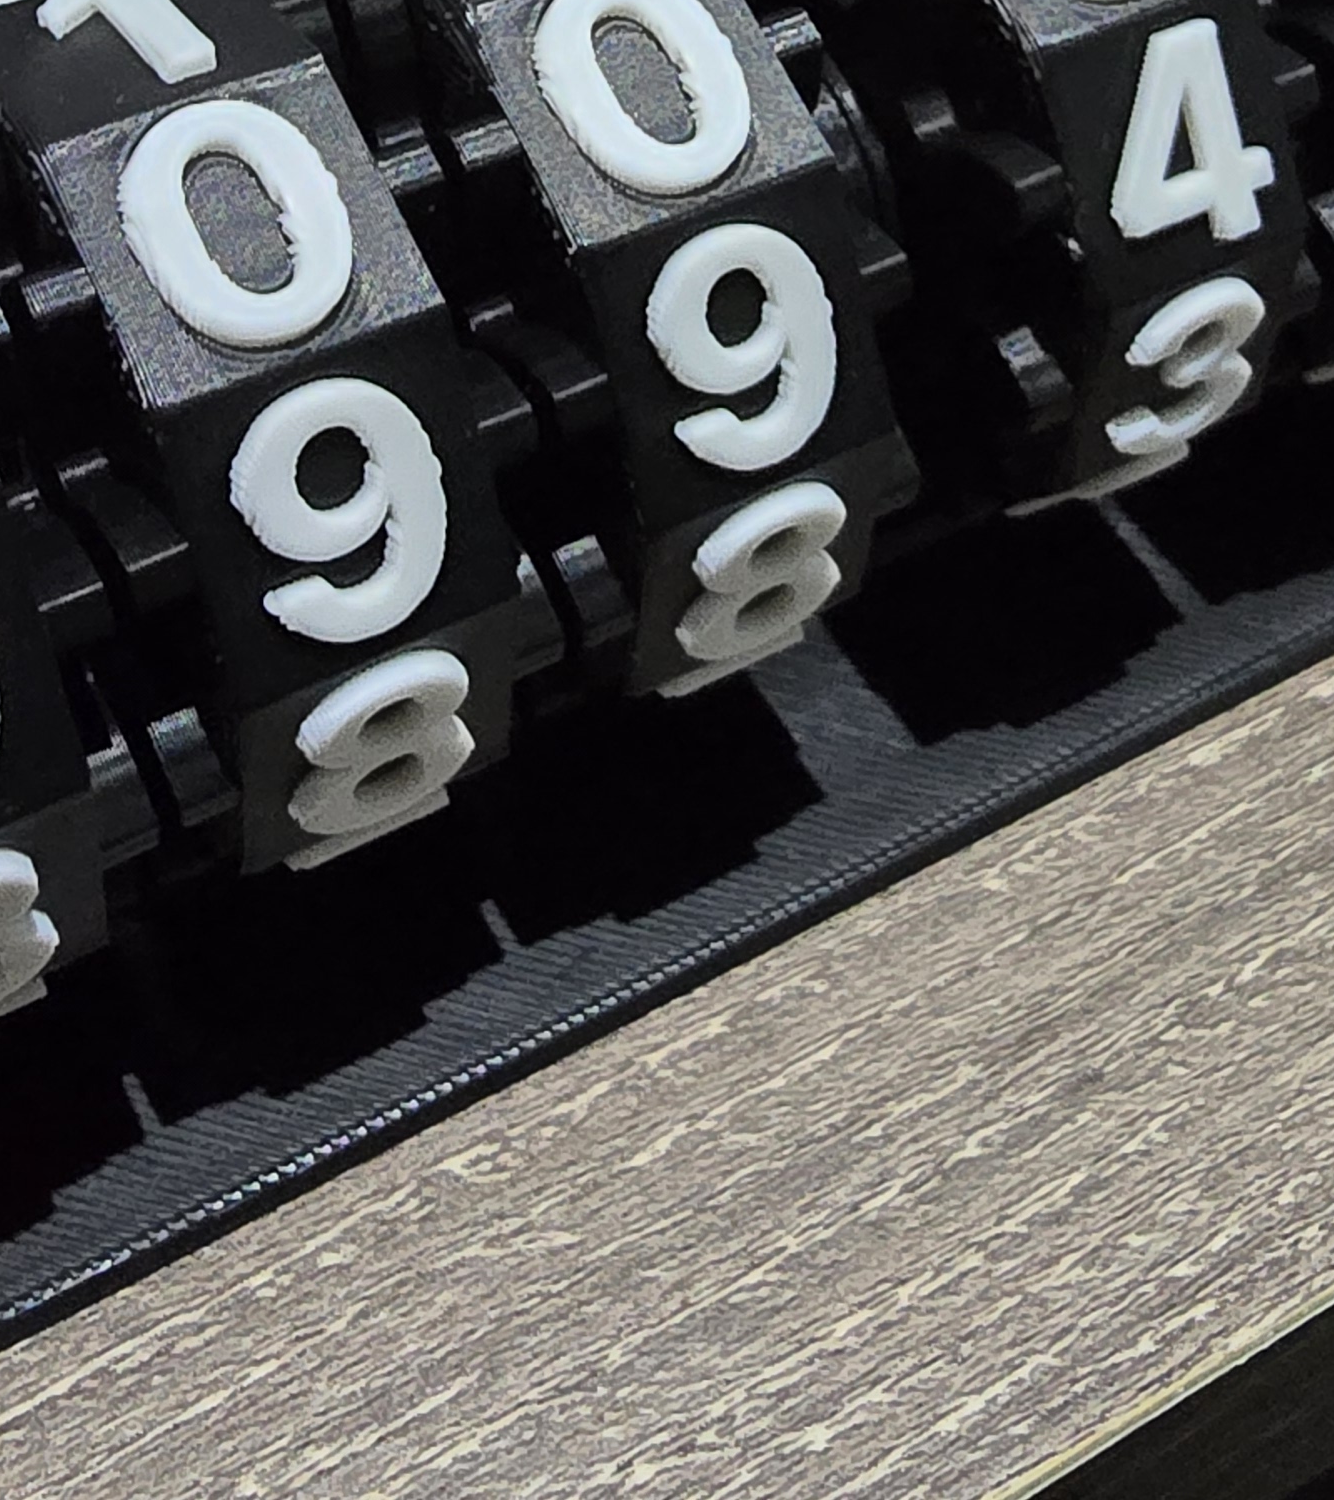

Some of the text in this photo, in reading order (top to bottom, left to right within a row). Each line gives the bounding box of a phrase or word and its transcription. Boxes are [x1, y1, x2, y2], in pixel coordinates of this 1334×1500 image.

[118, 100, 354, 347] 0
[229, 377, 447, 643] 9
[646, 223, 837, 471] 9
[1110, 18, 1274, 240] 4
[288, 649, 475, 835] 8
[676, 481, 847, 661] 8
[1106, 276, 1266, 454] 3
